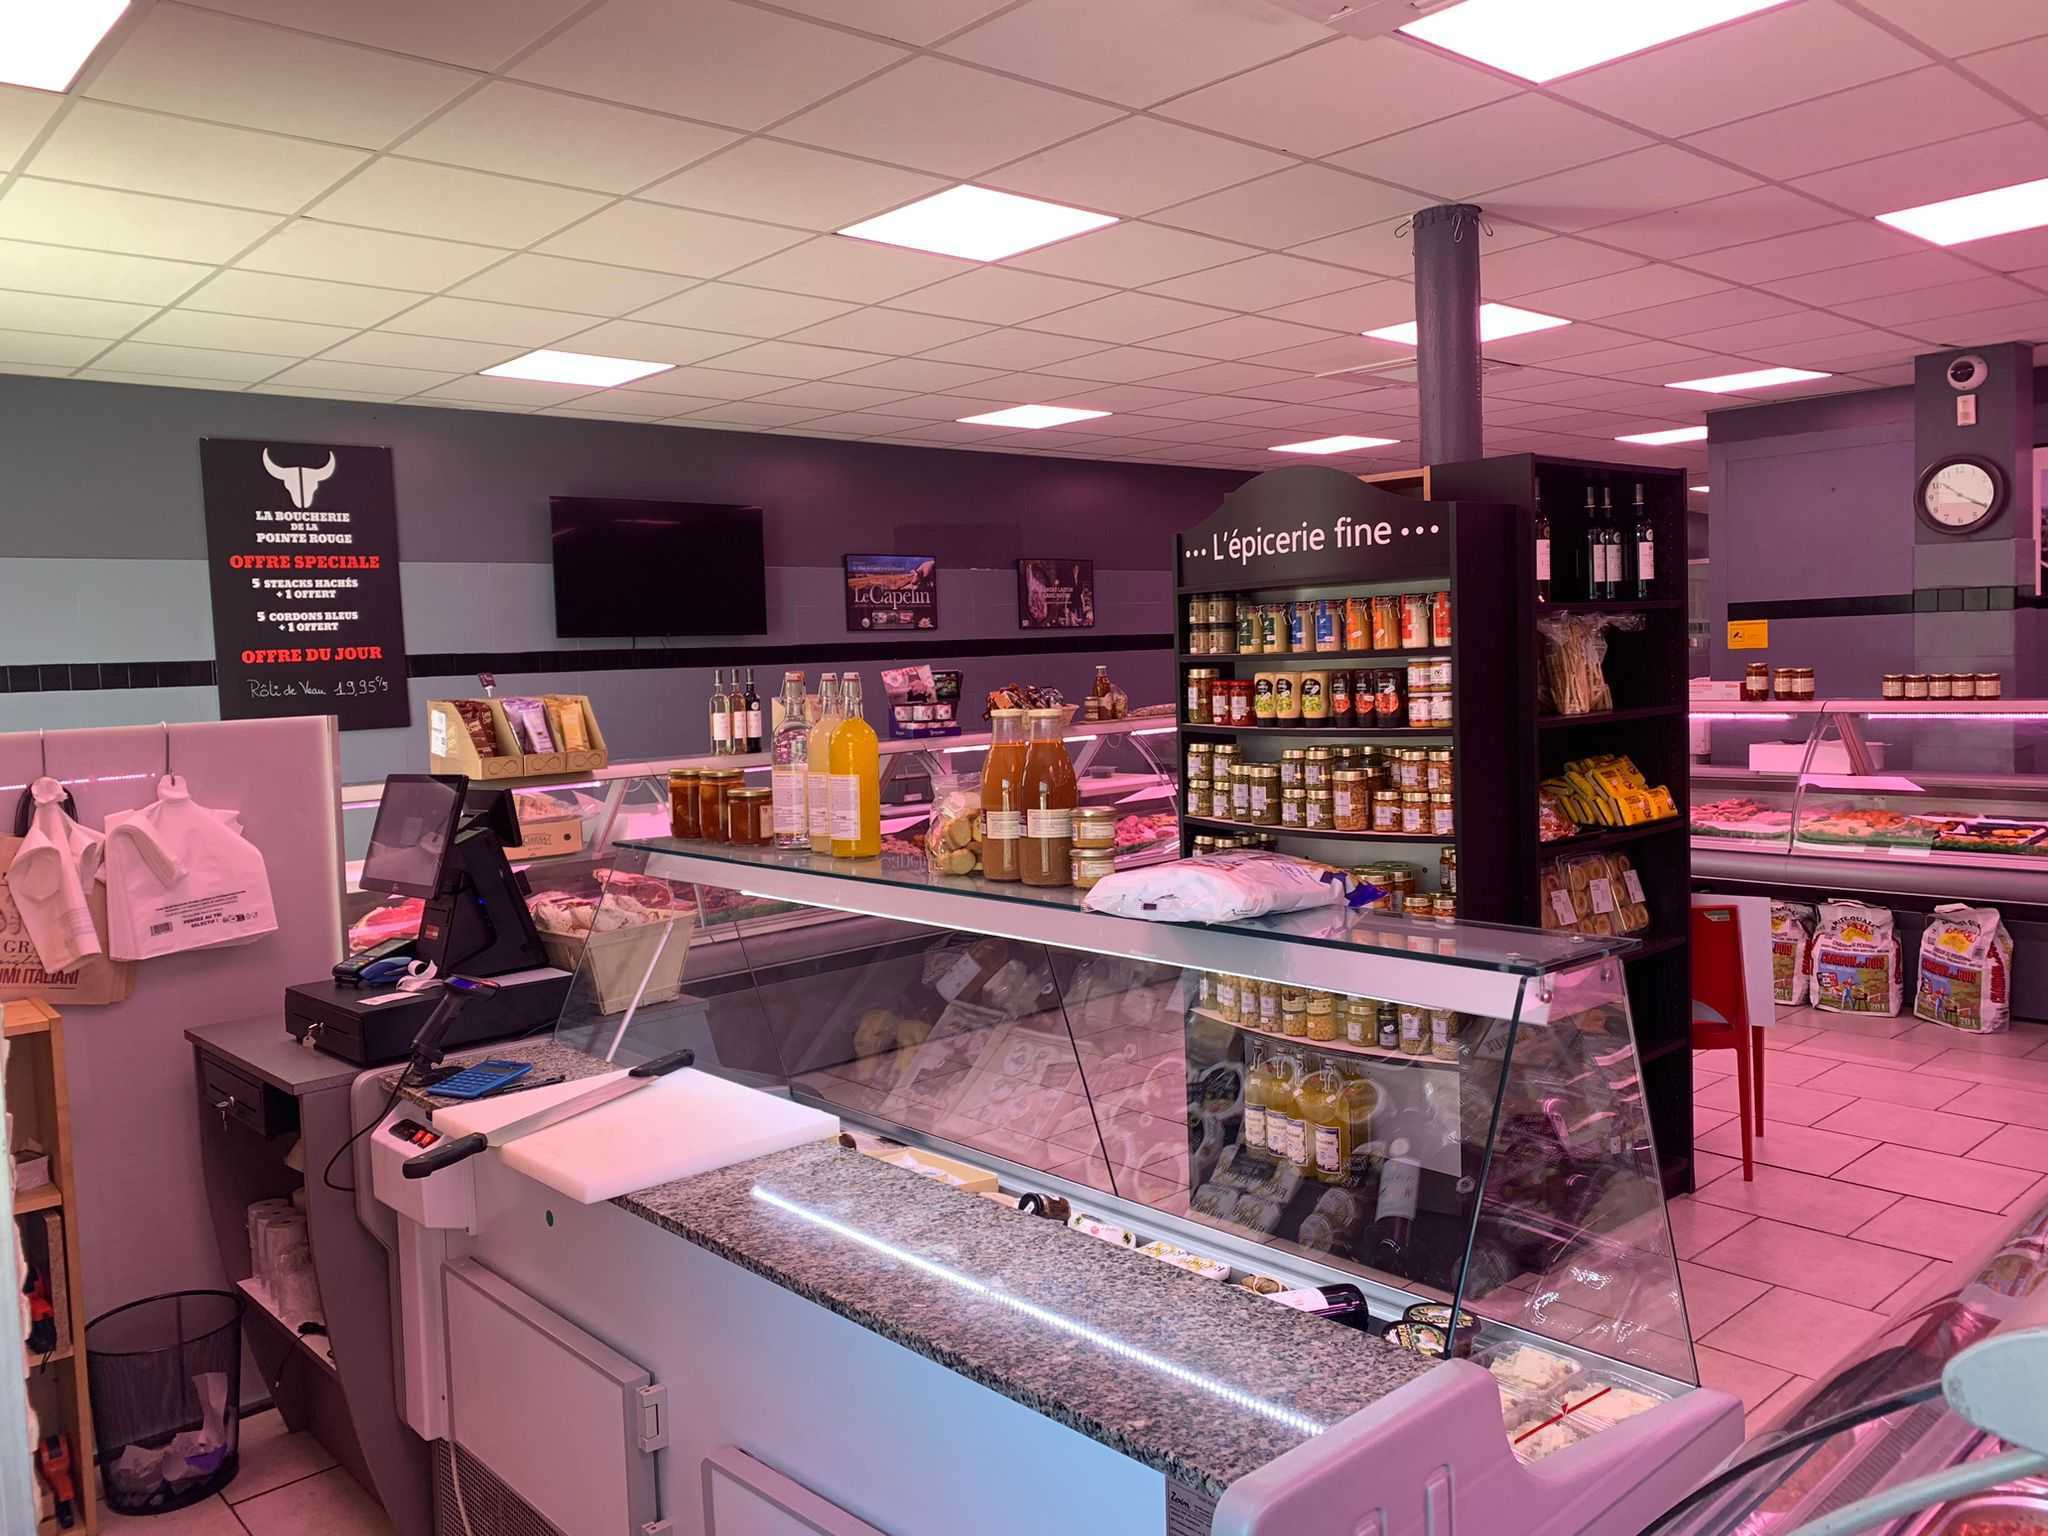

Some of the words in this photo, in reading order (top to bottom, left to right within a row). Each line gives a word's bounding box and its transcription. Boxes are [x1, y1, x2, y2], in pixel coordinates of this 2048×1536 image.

[255, 511, 273, 521] LA
[275, 511, 350, 522] BOUCHERIE
[290, 523, 304, 531] DE
[306, 523, 318, 531] LA
[256, 533, 307, 544] POINTE
[309, 534, 352, 543] ROUGE
[1213, 520, 1325, 566] L'épicerie
[1334, 517, 1393, 549] fine
[229, 555, 291, 569] OFFRE
[294, 555, 381, 569] SPECIALE
[251, 578, 261, 588] 5
[264, 580, 313, 588] STEACKS
[315, 577, 358, 588] HACHÉS
[276, 590, 283, 598] +
[285, 589, 292, 599] 1
[294, 590, 336, 599] OFFERT
[854, 587, 869, 603] Le
[869, 585, 931, 610] Capelin
[257, 612, 265, 621] 5
[269, 612, 322, 621] CORDONS
[324, 612, 358, 620] BLEUS
[288, 623, 295, 632] 1
[296, 623, 339, 631] OFFERT
[241, 649, 301, 664] OFFRE
[306, 648, 331, 661] DU
[335, 646, 382, 660] JOUR
[283, 684, 296, 696] de
[298, 680, 326, 696] Veau
[22, 968, 79, 984] ITALIANI
